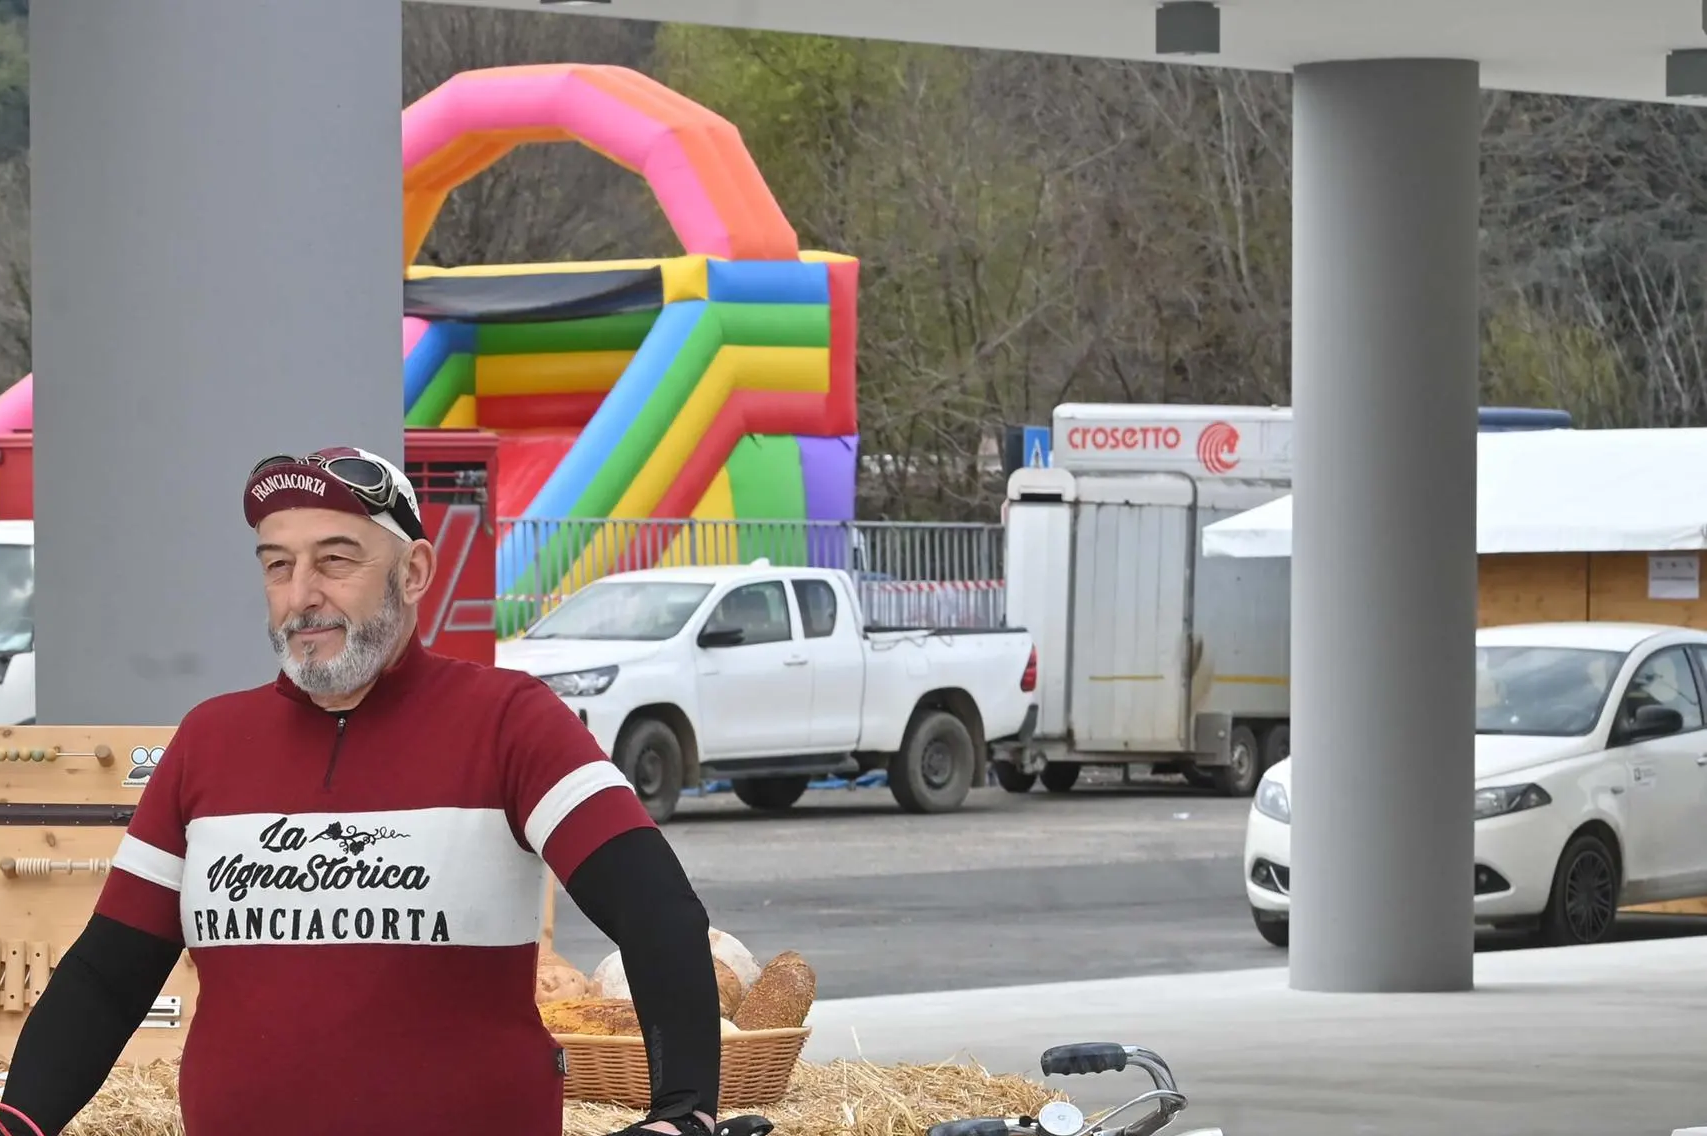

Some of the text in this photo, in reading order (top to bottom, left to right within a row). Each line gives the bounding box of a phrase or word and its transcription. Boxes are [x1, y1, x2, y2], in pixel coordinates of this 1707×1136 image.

[251, 473, 327, 502] FRANCIACORTA
[259, 817, 308, 852] La
[207, 854, 430, 902] VignaStorica
[194, 908, 450, 942] FRANCIACORTA
